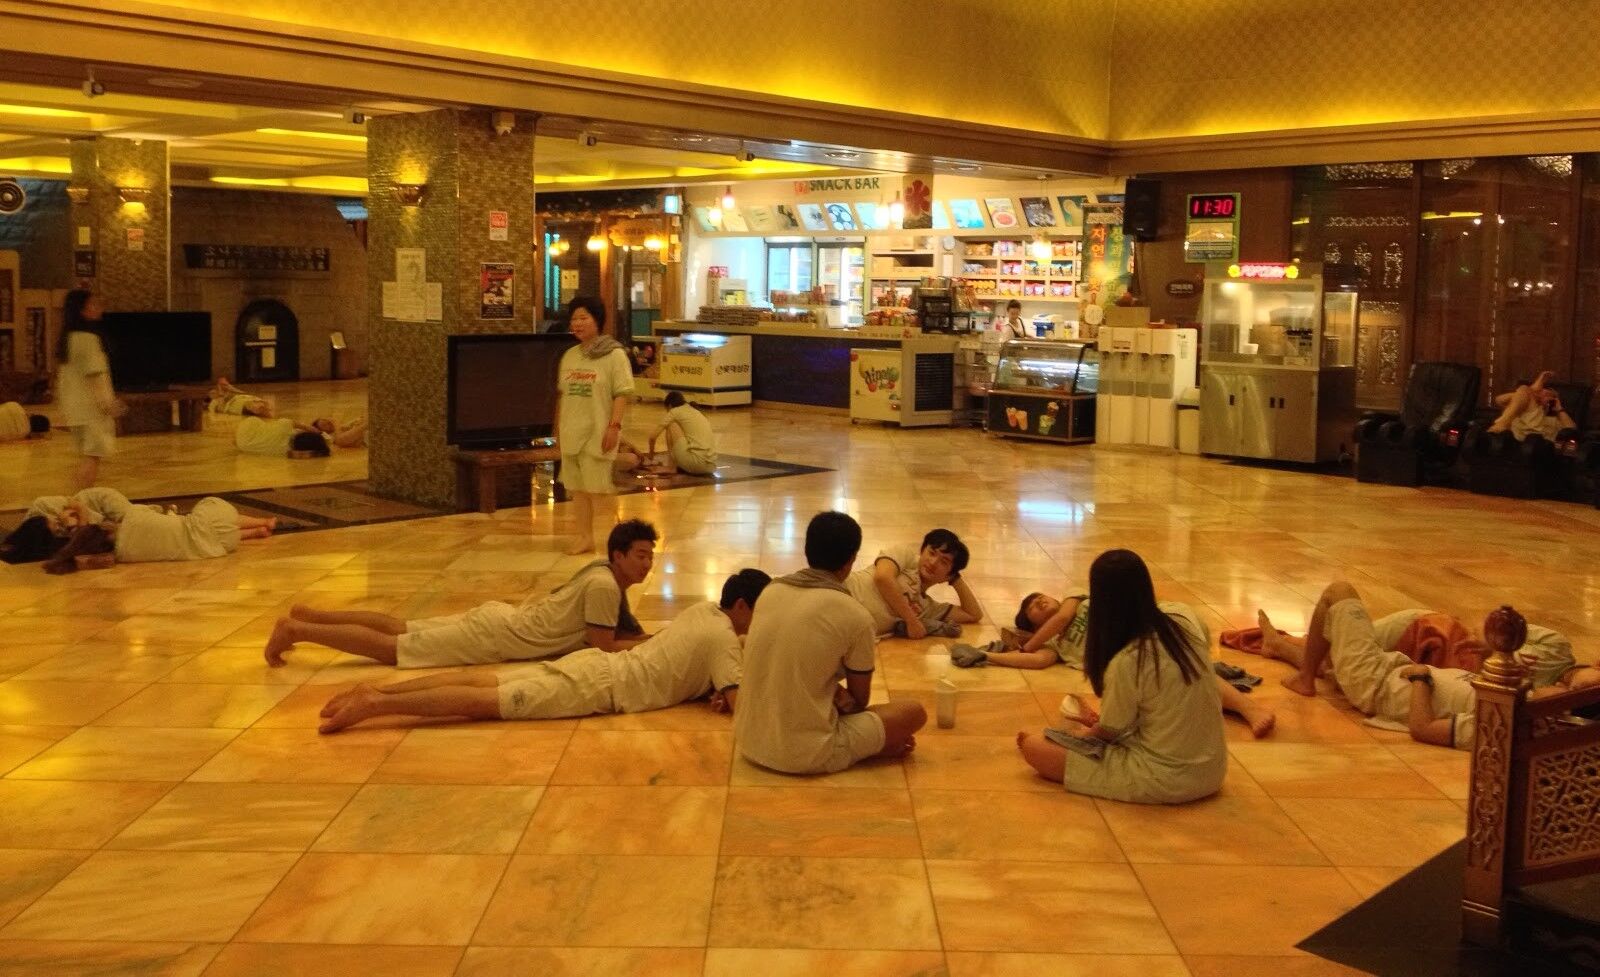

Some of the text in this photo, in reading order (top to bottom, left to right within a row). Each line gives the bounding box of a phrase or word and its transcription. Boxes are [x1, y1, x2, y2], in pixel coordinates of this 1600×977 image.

[810, 177, 880, 192] SNACK BAR
[1191, 199, 1234, 216] 11:30
